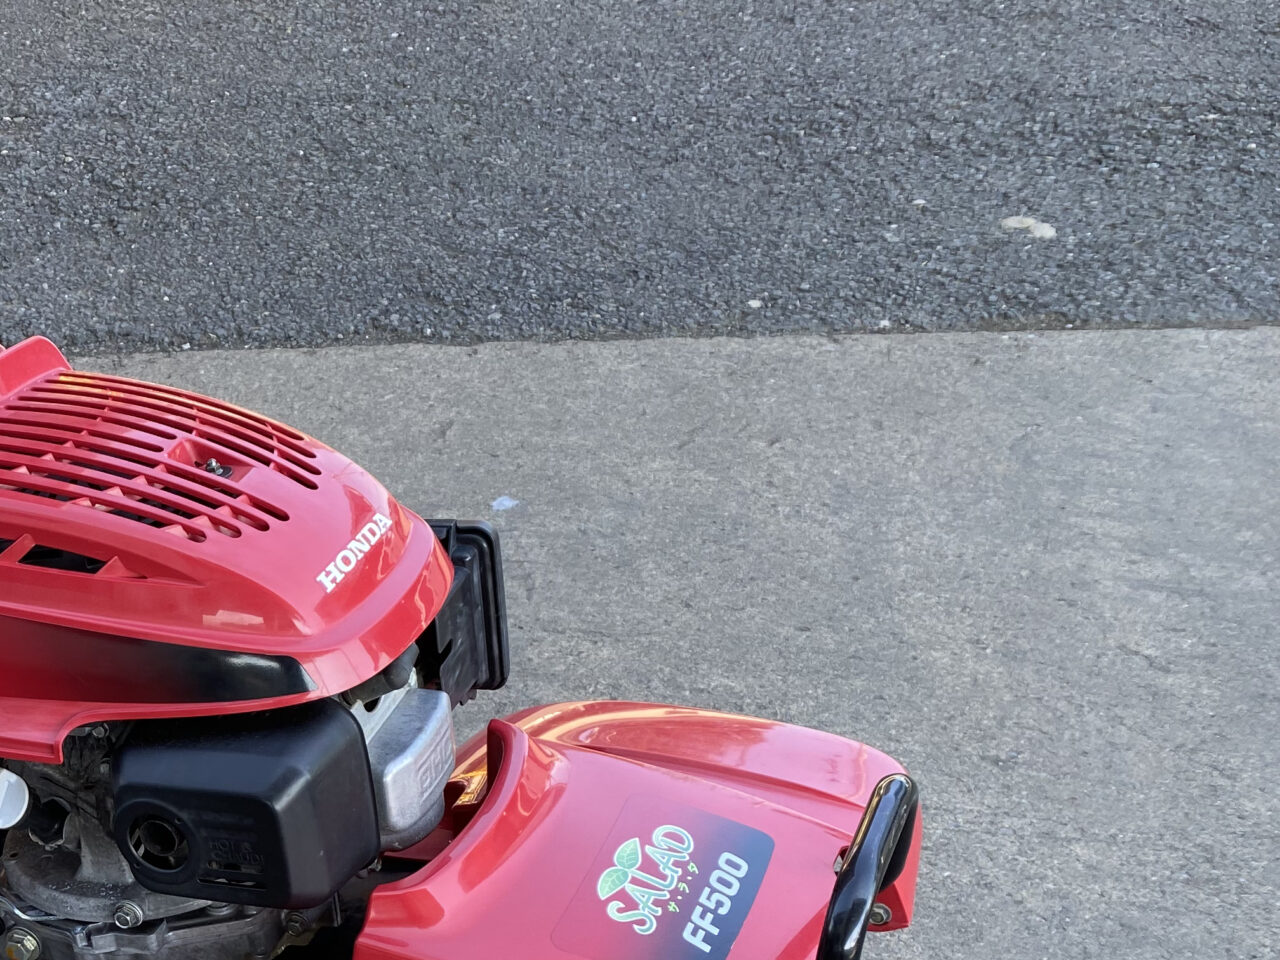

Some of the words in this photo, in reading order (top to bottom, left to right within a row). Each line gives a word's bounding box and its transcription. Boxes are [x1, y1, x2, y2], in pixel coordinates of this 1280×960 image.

[316, 513, 392, 593] HONDA
[606, 824, 694, 935] SALAD
[682, 851, 749, 953] FF500
